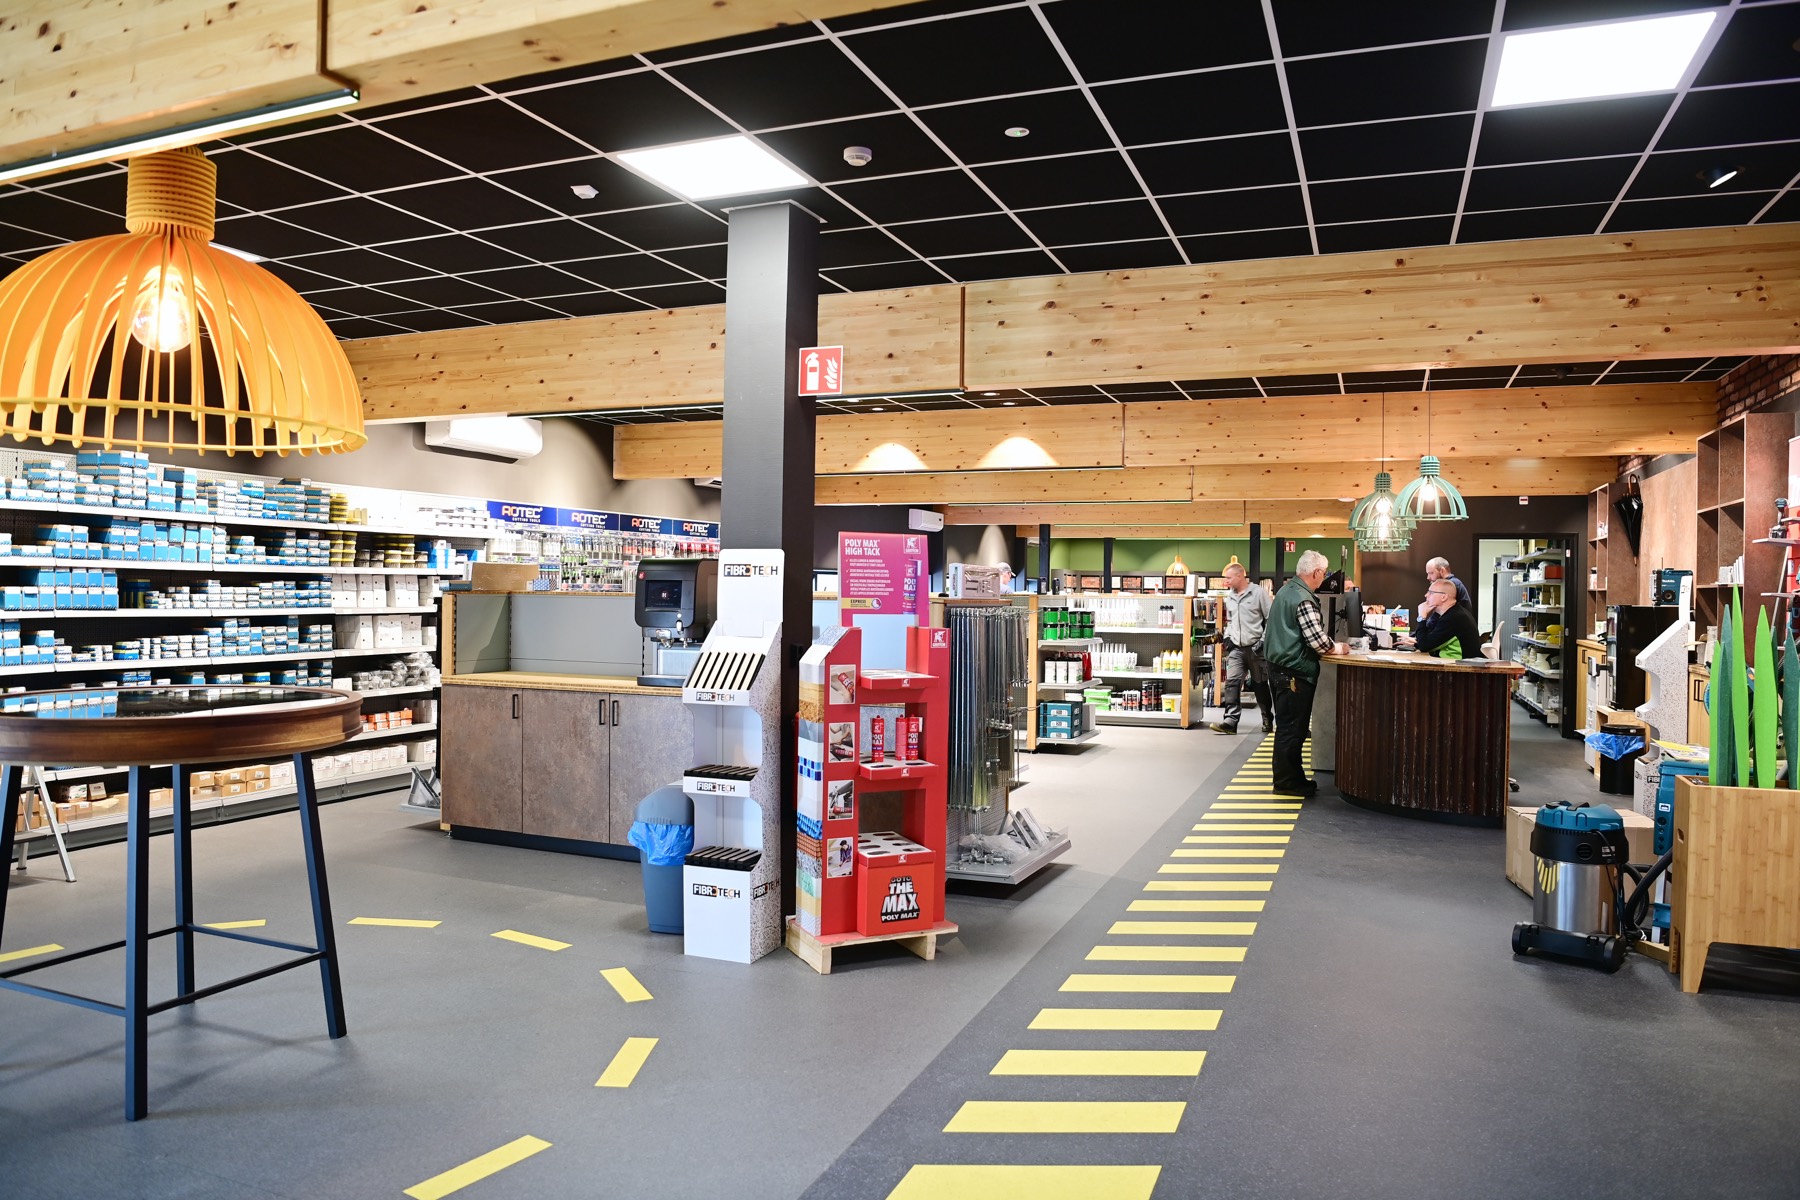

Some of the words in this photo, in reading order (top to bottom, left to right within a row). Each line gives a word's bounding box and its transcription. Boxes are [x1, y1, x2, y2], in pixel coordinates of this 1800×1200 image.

[502, 505, 541, 519] ROTEC
[571, 512, 606, 525] ROTEC
[631, 517, 660, 529] ROTEC
[683, 522, 708, 533] ROTEC
[845, 538, 862, 547] POLY
[863, 539, 878, 548] MAX
[845, 547, 862, 556] HIGH
[864, 547, 880, 556] TACK
[889, 882, 914, 894] THE
[882, 893, 918, 913] MAX
